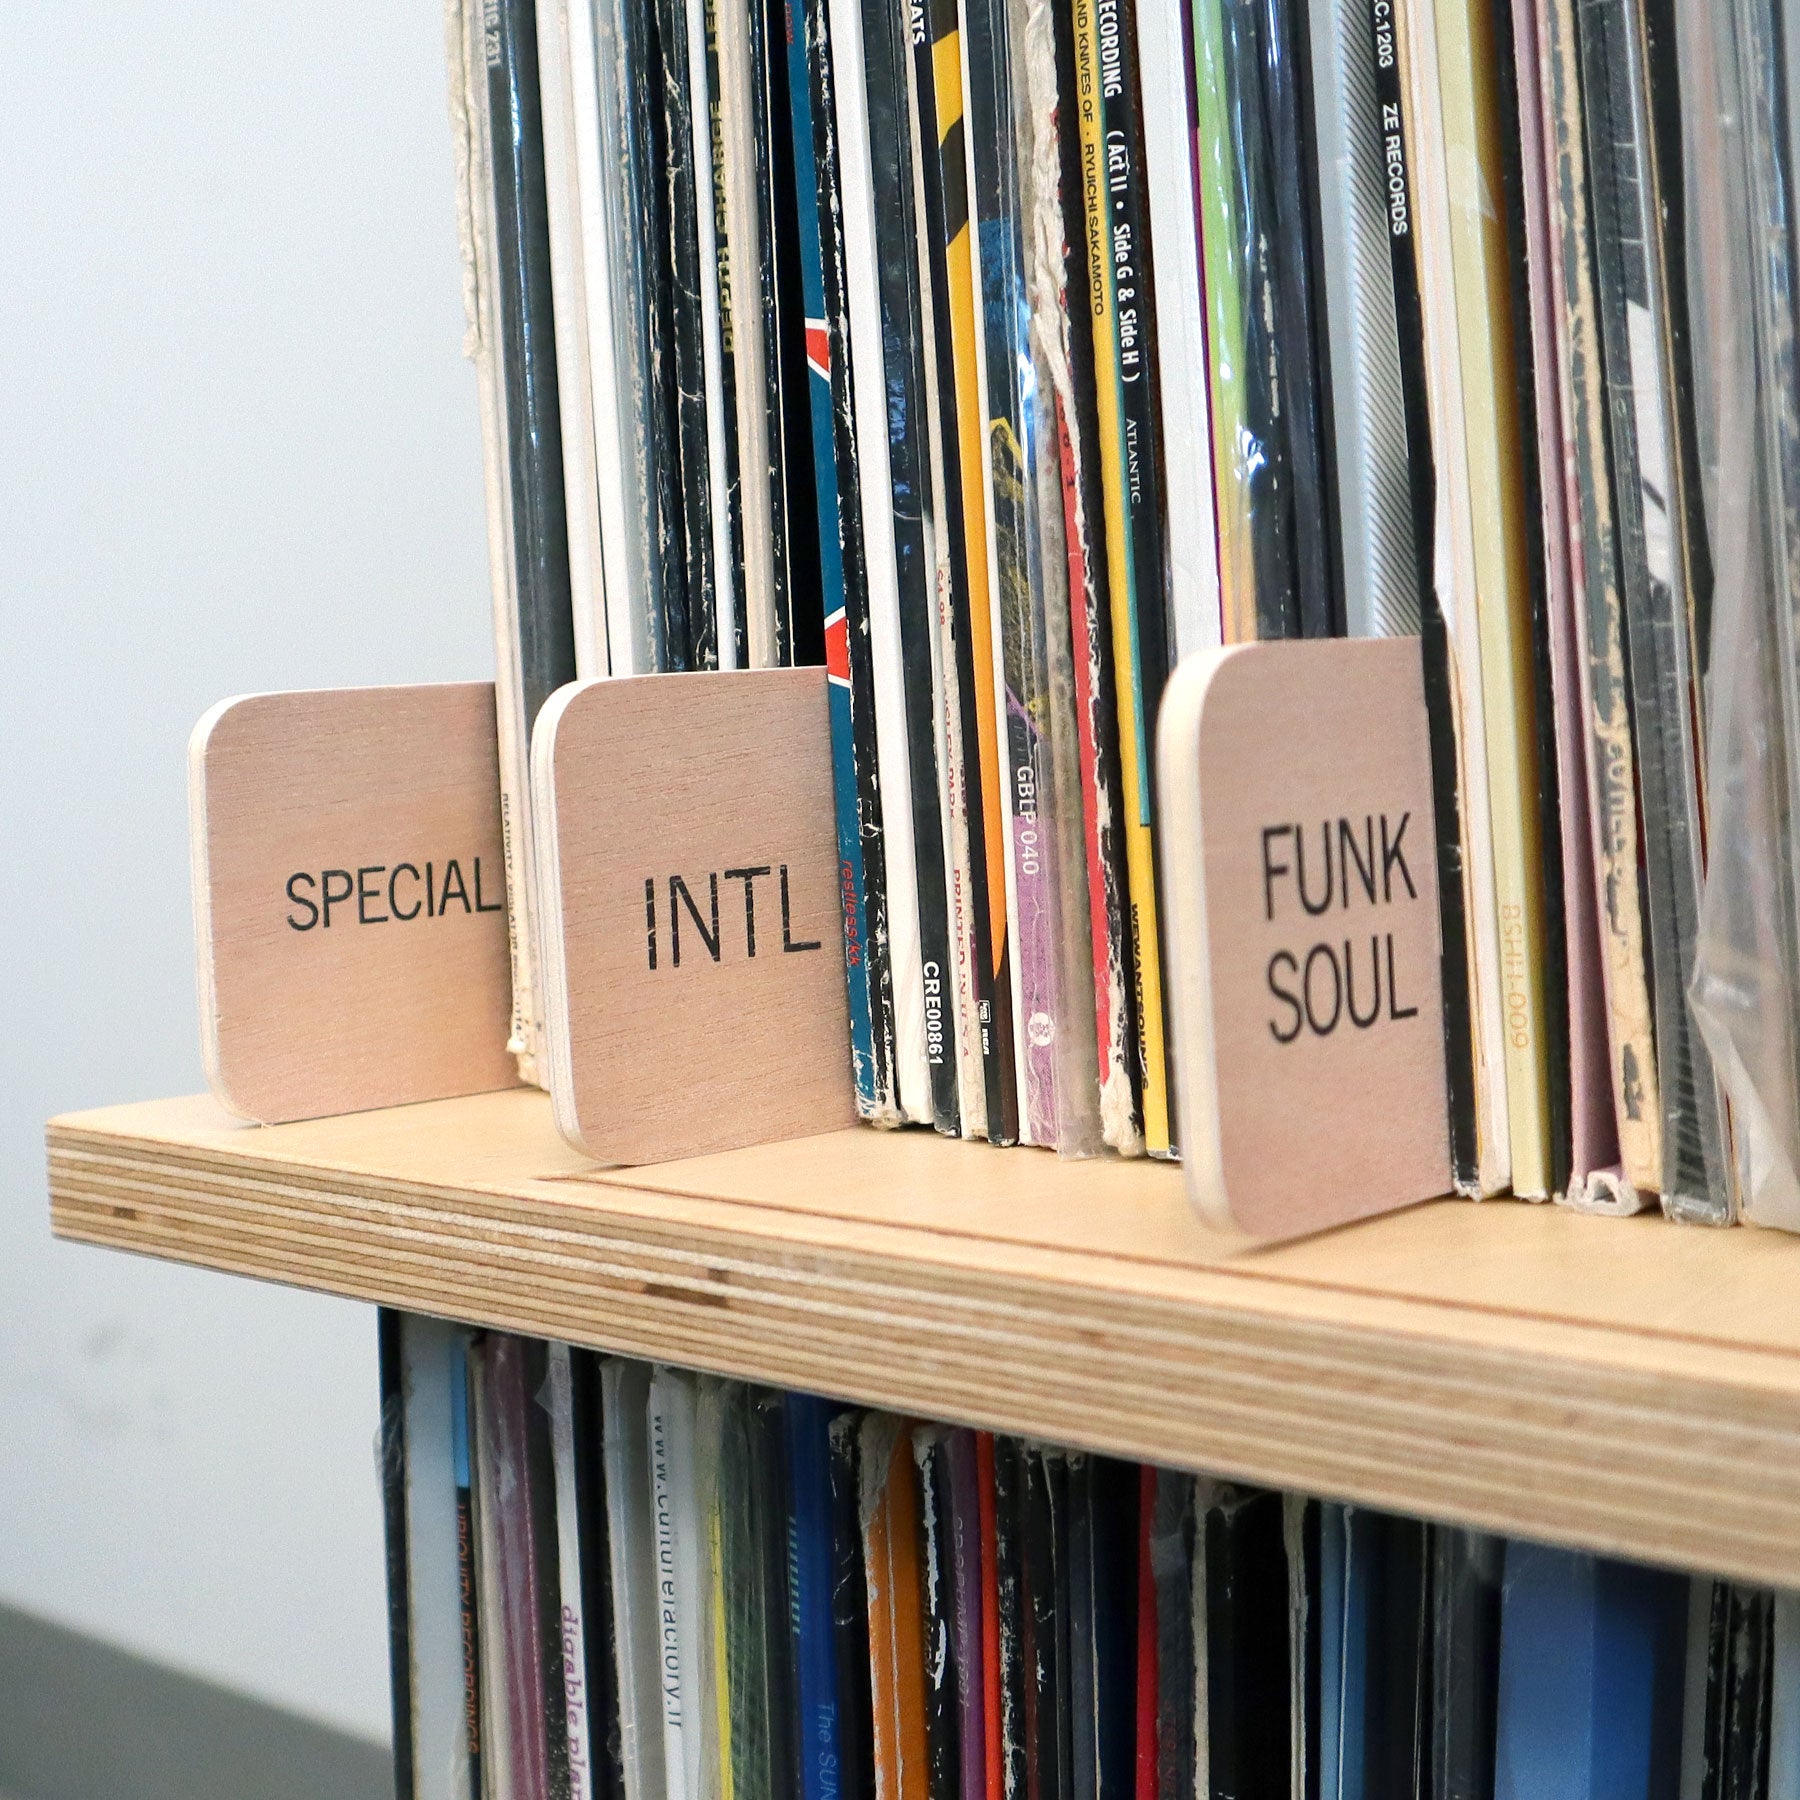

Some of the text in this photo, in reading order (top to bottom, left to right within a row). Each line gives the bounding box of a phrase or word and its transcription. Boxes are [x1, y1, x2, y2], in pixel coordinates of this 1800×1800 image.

[909, 0, 926, 45] ATS
[1098, 0, 1122, 98] ECORDING
[1076, 0, 1104, 316] ND KNIVES OF RYUICHI SAKAMOTO
[1382, 102, 1408, 236] ZE RECORDS
[1113, 222, 1132, 262] Side
[1116, 265, 1134, 280] G
[1117, 287, 1135, 302] &
[1119, 308, 1138, 348] Side
[1125, 418, 1142, 504] ATLANTIC
[1016, 765, 1040, 876] GBLP 040
[1261, 812, 1418, 921] FUNK
[286, 856, 504, 932] SPECIAL
[644, 863, 822, 971] INTL
[922, 960, 945, 1066] CRE00861
[1131, 902, 1149, 1091] WEWANTSOUNDS
[1267, 932, 1419, 1043] SOUL
[981, 1028, 990, 1055] RCA
[561, 1604, 584, 1727] digable
[817, 1703, 836, 1743] The
